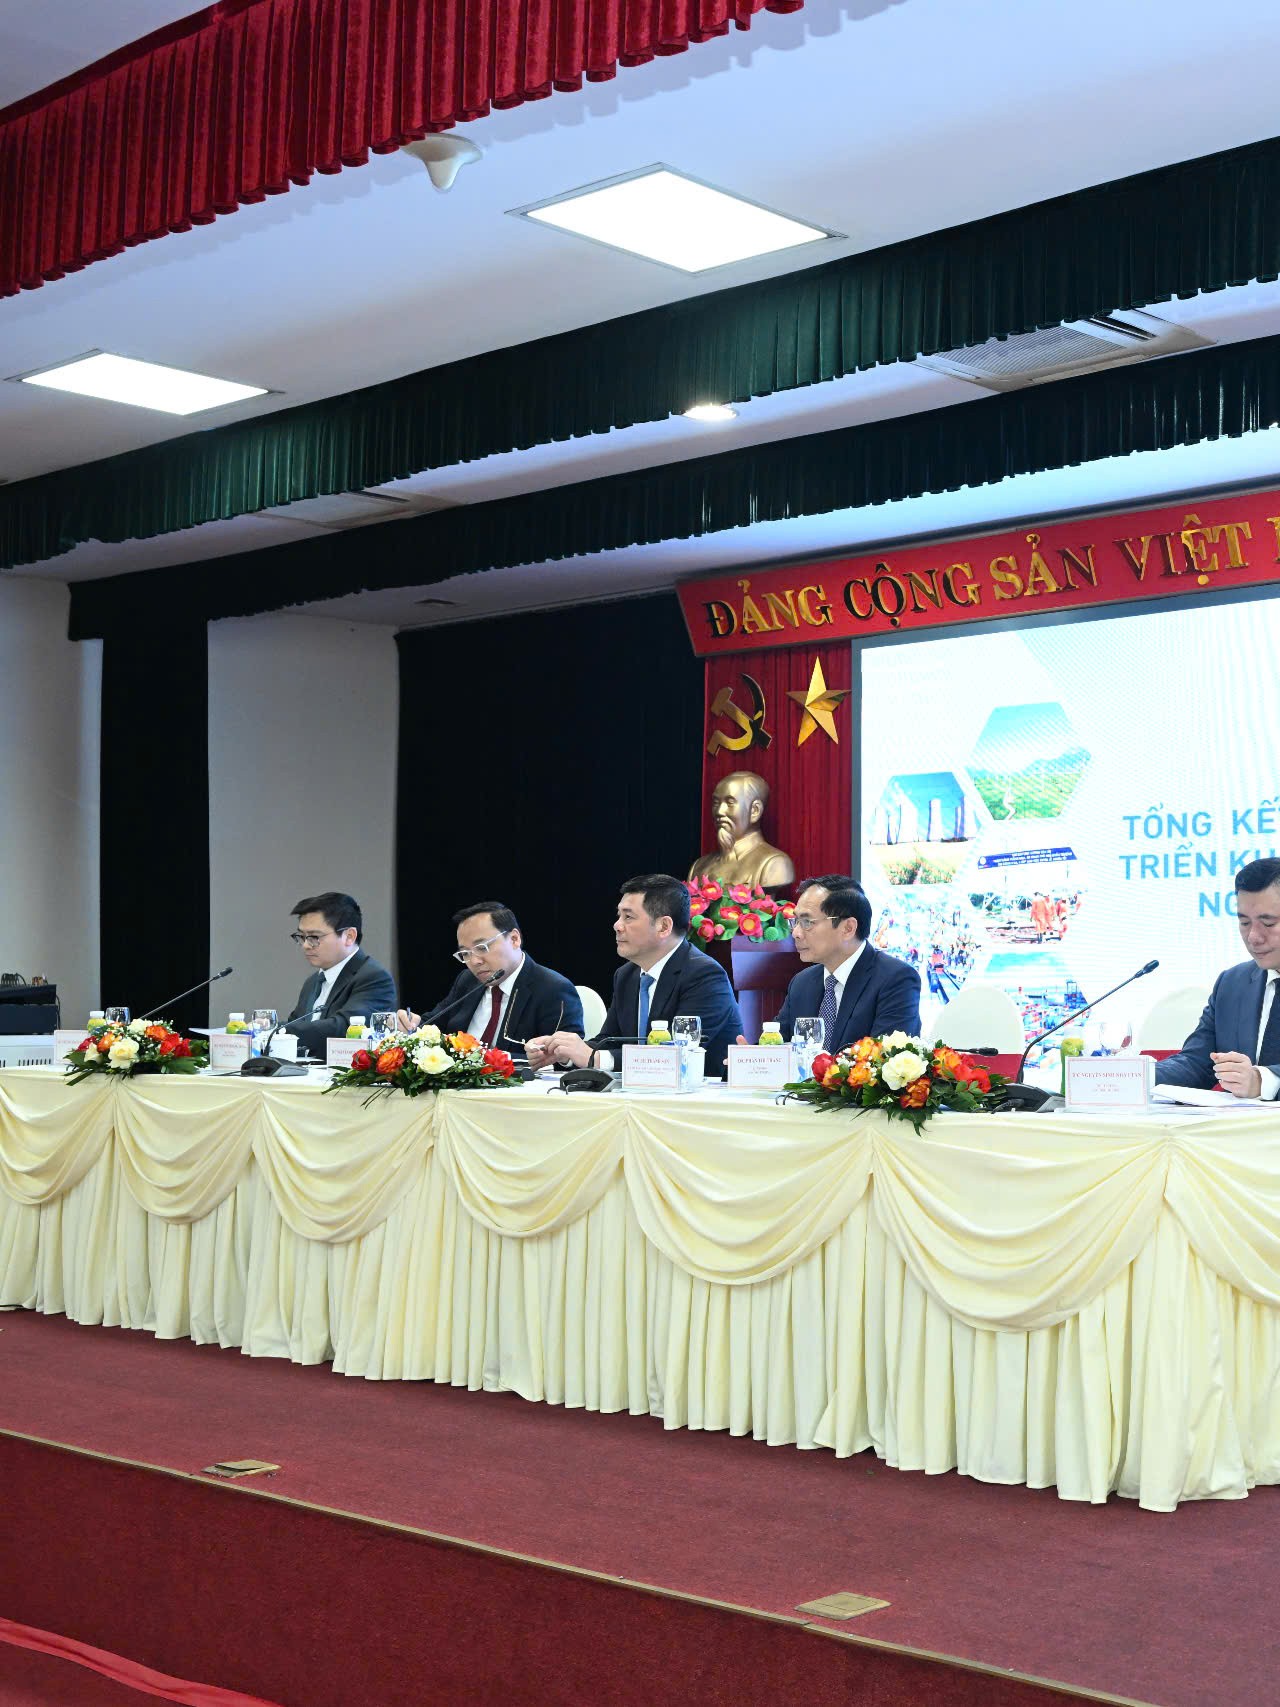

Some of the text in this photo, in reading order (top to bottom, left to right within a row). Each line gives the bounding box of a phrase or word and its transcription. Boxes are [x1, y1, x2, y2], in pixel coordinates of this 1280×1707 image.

[705, 579, 833, 639] ĐẢNG
[844, 562, 981, 627] CỘNG
[989, 532, 1100, 601] SẢN
[1115, 513, 1253, 585] VIỆT
[1122, 802, 1212, 840] TỔNG
[1118, 841, 1217, 881] TRIỂN
